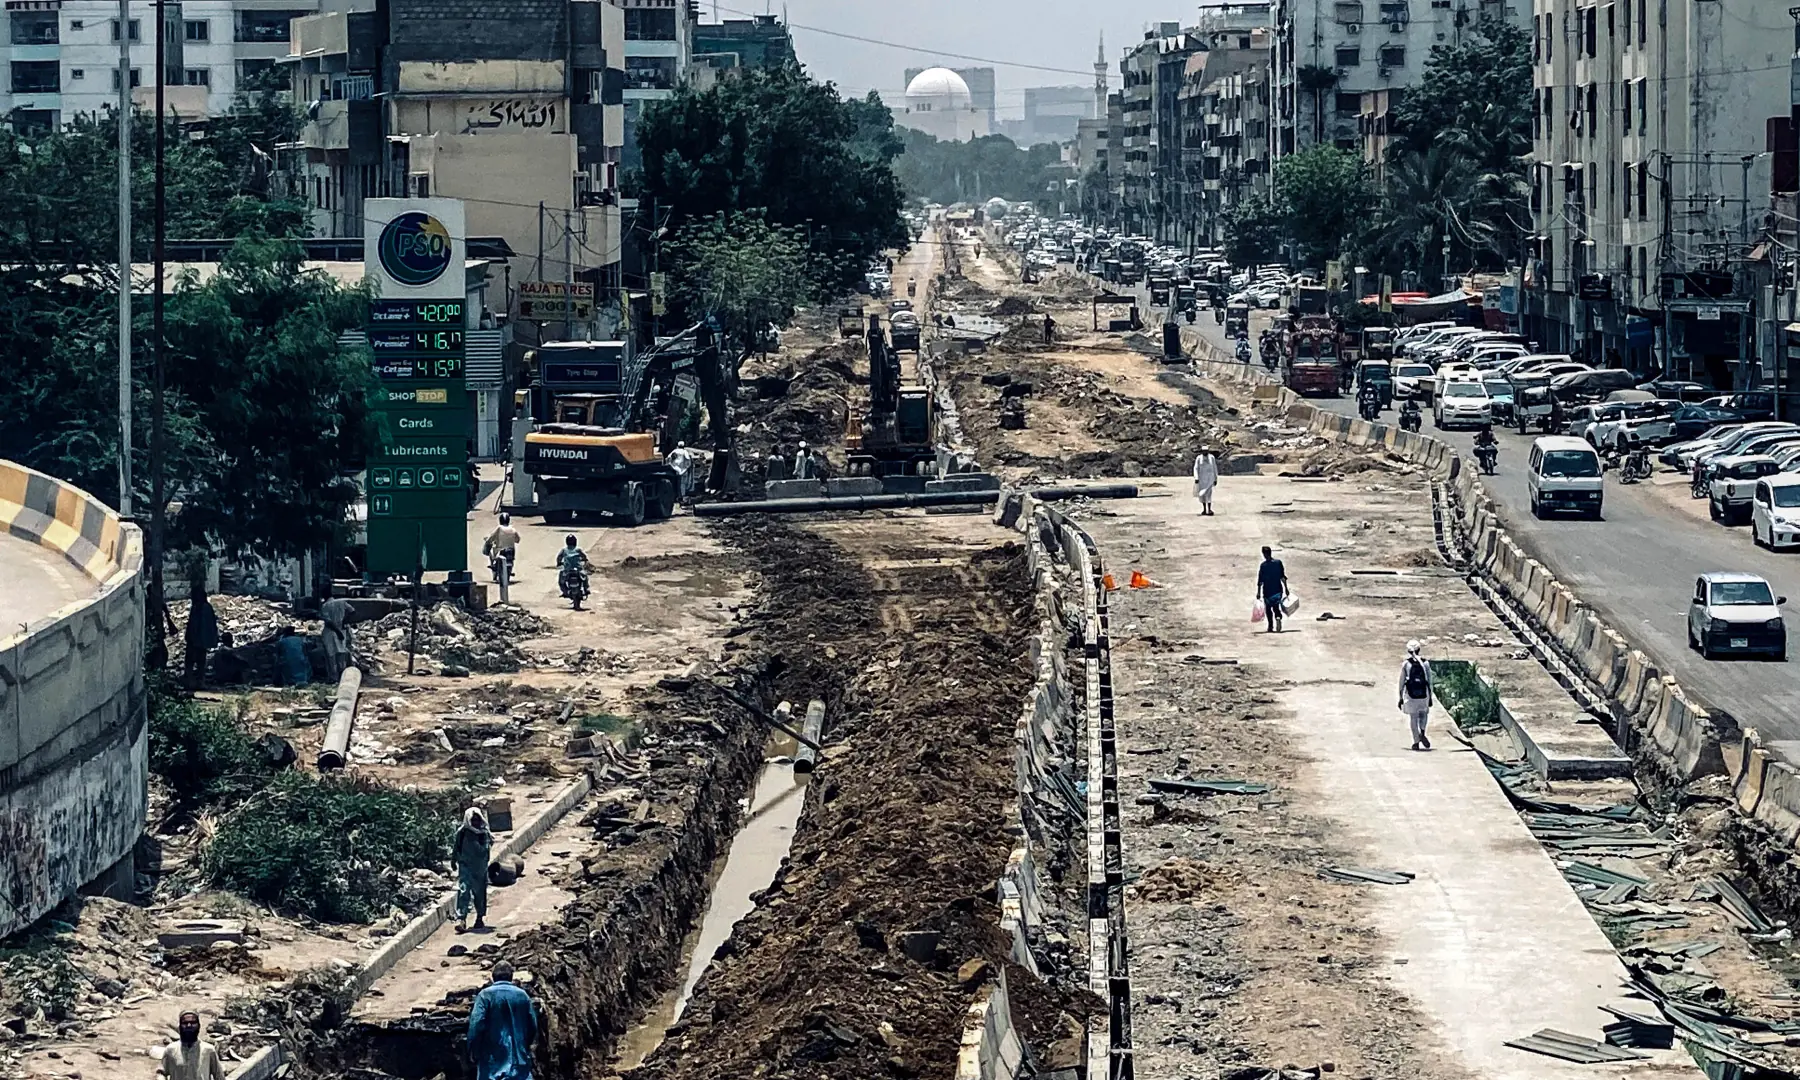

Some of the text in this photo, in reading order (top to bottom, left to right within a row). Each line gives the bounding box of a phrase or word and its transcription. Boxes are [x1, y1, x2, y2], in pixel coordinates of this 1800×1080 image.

[400, 233, 446, 258] PSO
[520, 283, 592, 295] RAJA TYRES
[388, 391, 444, 401] SHOP STOP
[398, 418, 433, 428] Cards
[539, 448, 588, 460] HYUNDAI
